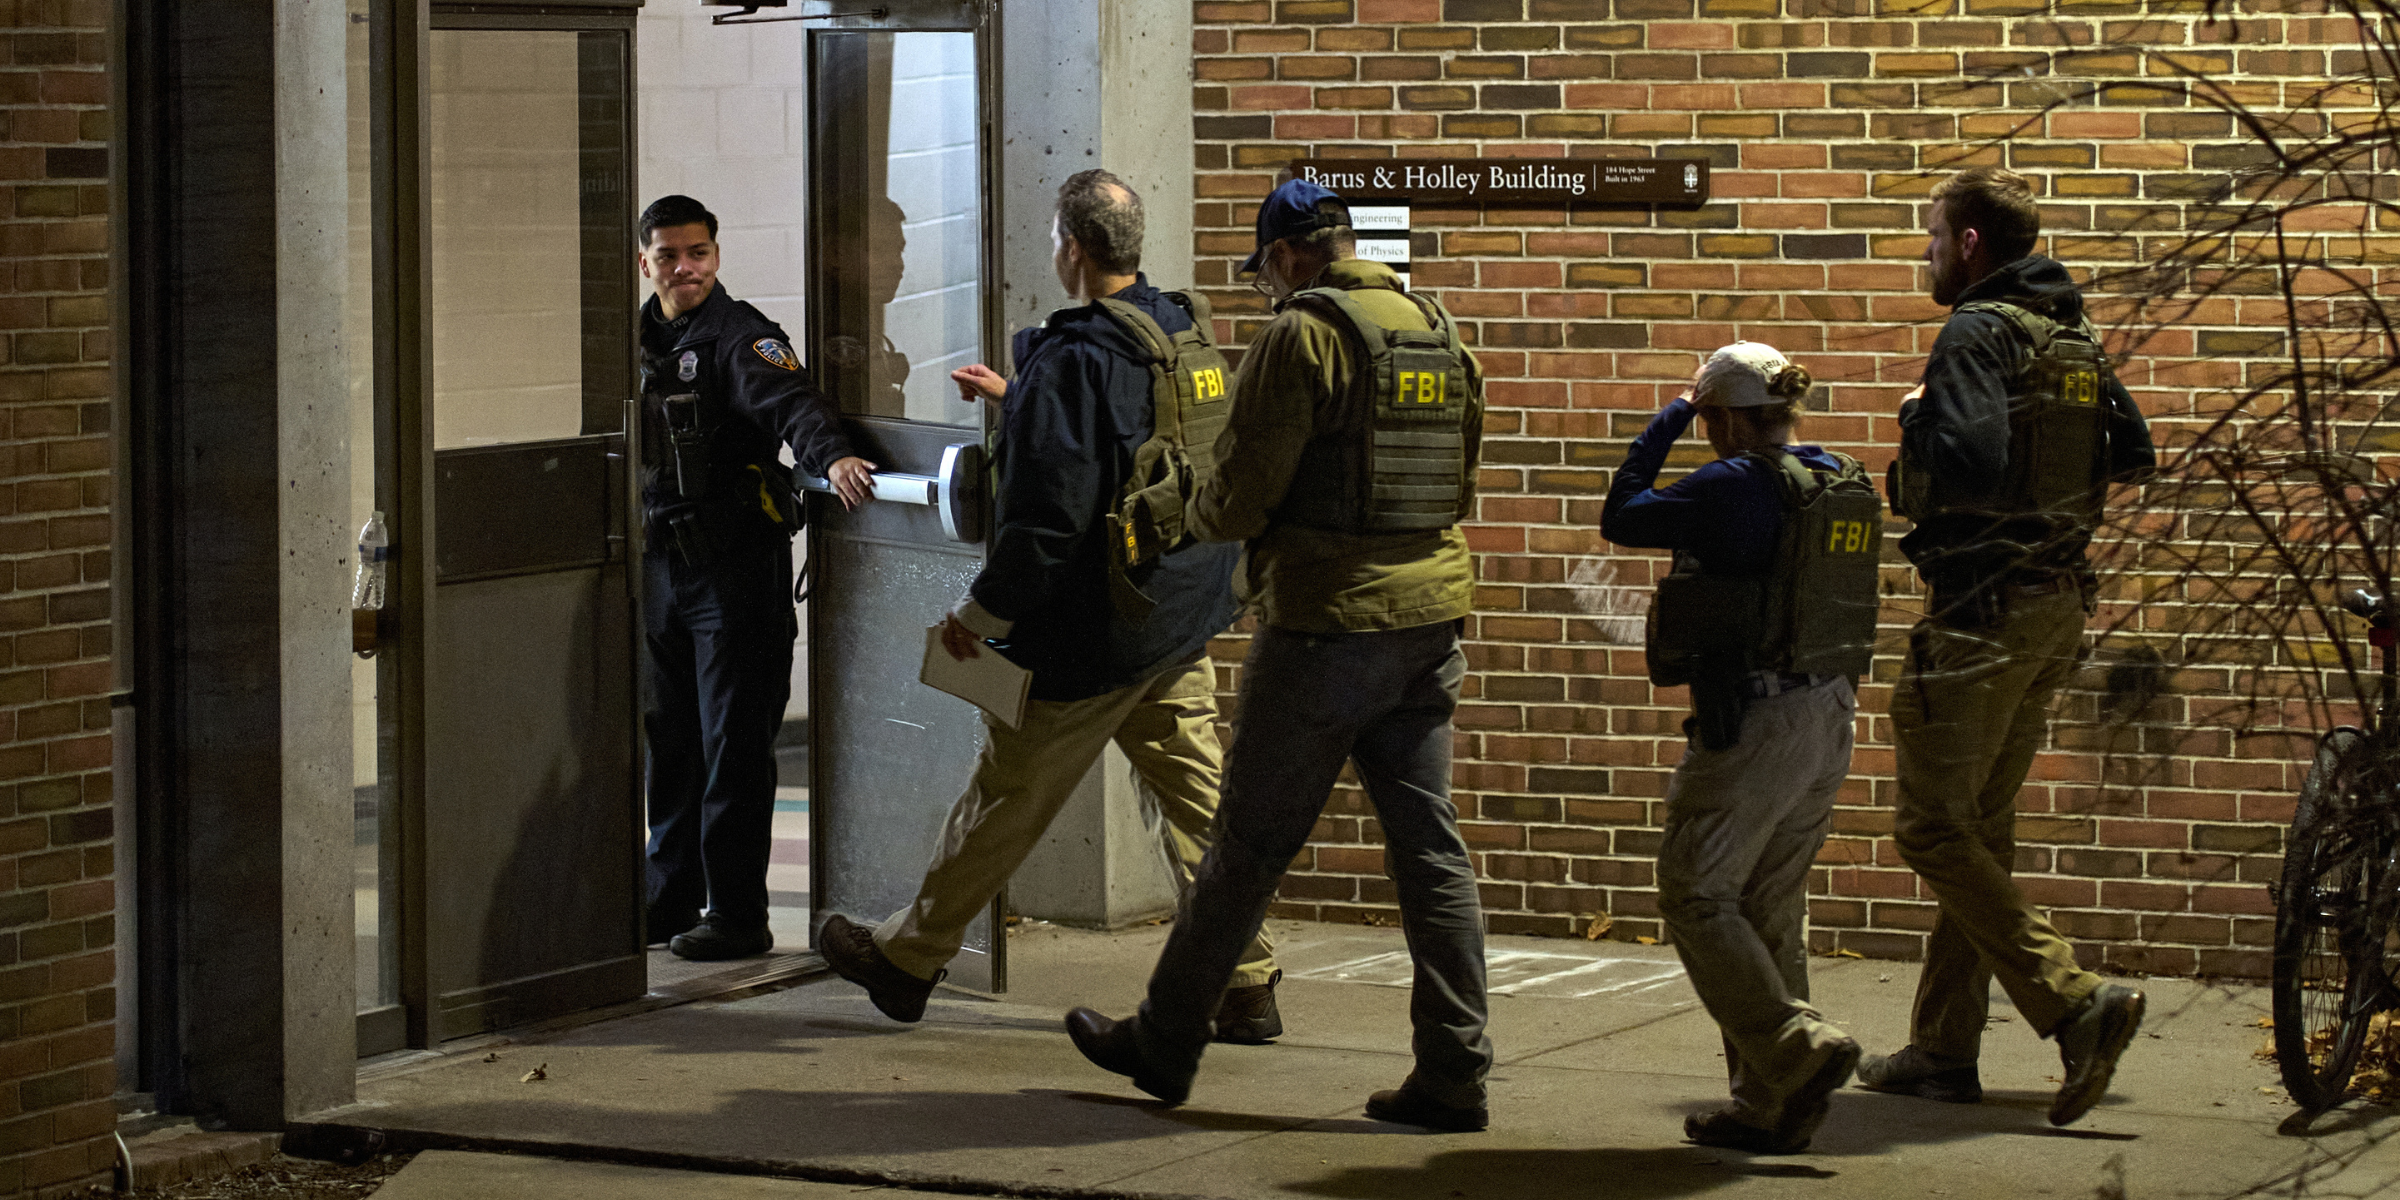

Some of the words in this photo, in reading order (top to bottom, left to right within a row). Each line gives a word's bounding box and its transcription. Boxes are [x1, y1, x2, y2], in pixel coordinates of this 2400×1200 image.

[1303, 166, 1365, 188] Barus
[1373, 166, 1396, 189] &
[1404, 165, 1481, 195] Holley
[1489, 165, 1586, 195] Building
[1619, 166, 1636, 175] Hope
[1352, 213, 1403, 225] ngineering
[1357, 245, 1368, 256] of
[1370, 245, 1404, 257] Physics
[1193, 368, 1224, 400] FBI
[1397, 371, 1446, 404] FBI
[2065, 371, 2098, 403] FBI
[1124, 522, 1136, 561] FBI
[1829, 520, 1871, 552] FBI
